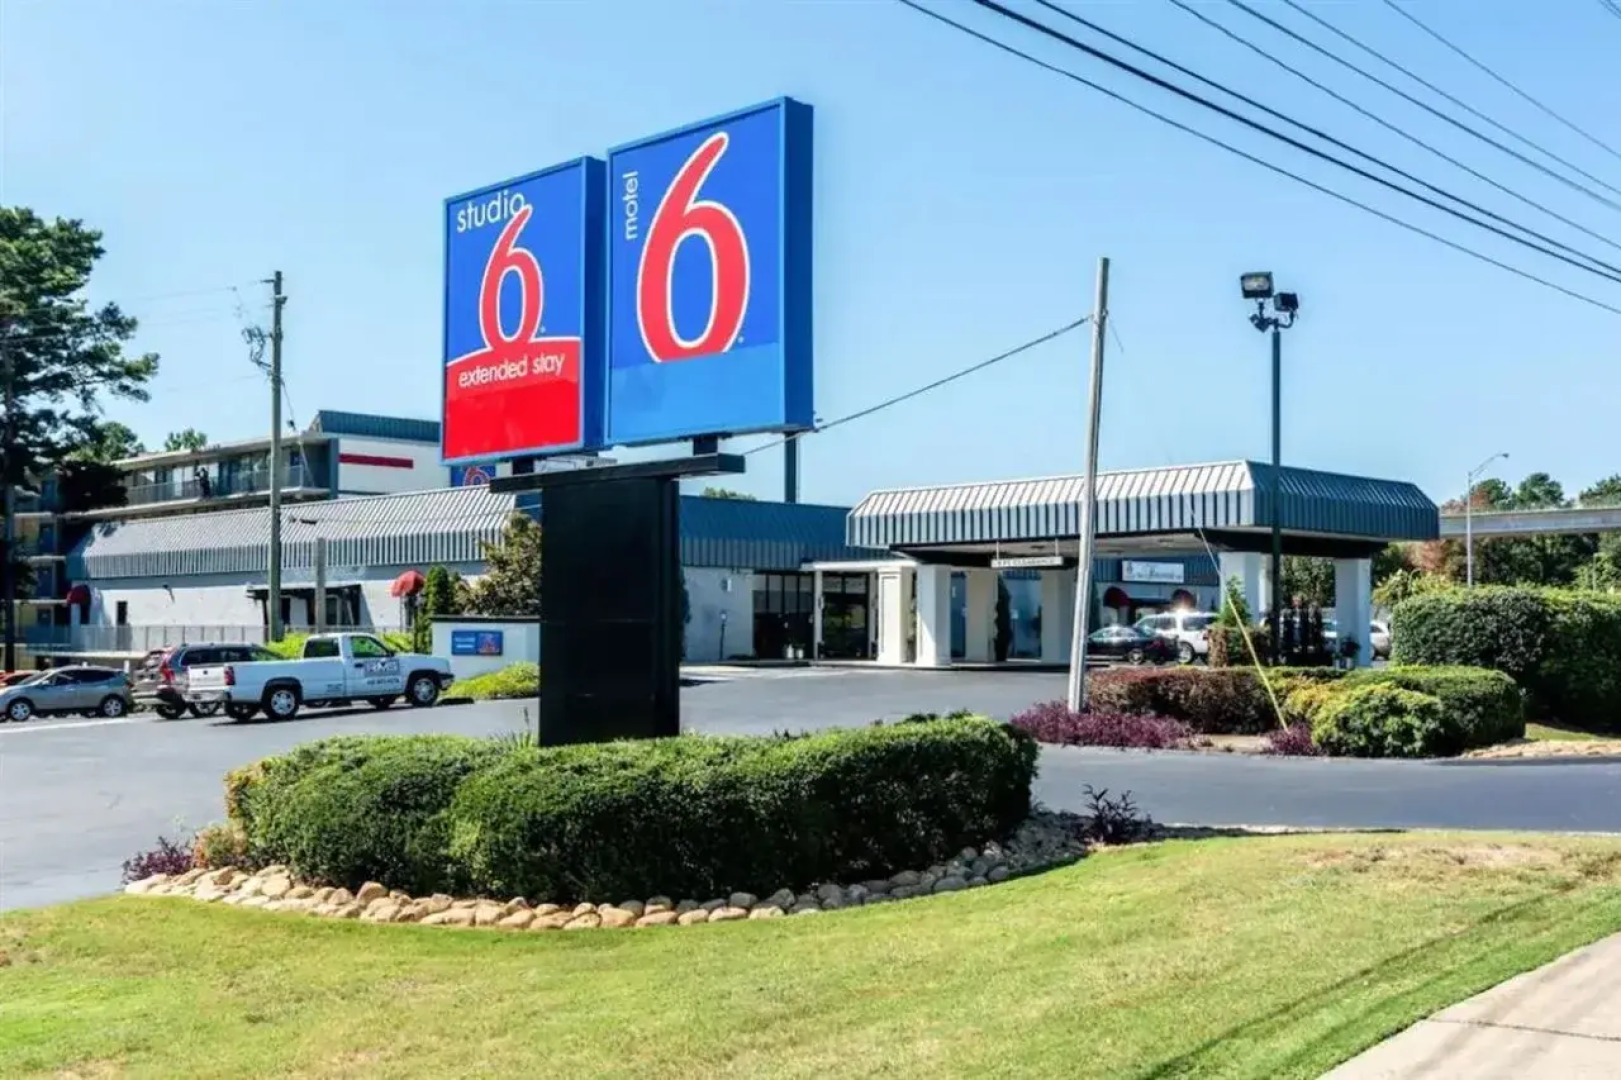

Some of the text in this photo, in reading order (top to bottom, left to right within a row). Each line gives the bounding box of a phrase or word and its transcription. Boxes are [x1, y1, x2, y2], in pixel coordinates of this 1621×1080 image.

[457, 190, 525, 233] studio
[622, 171, 638, 240] motel
[479, 204, 543, 350] 6
[636, 132, 750, 363] 6
[458, 353, 566, 388] extended stay
